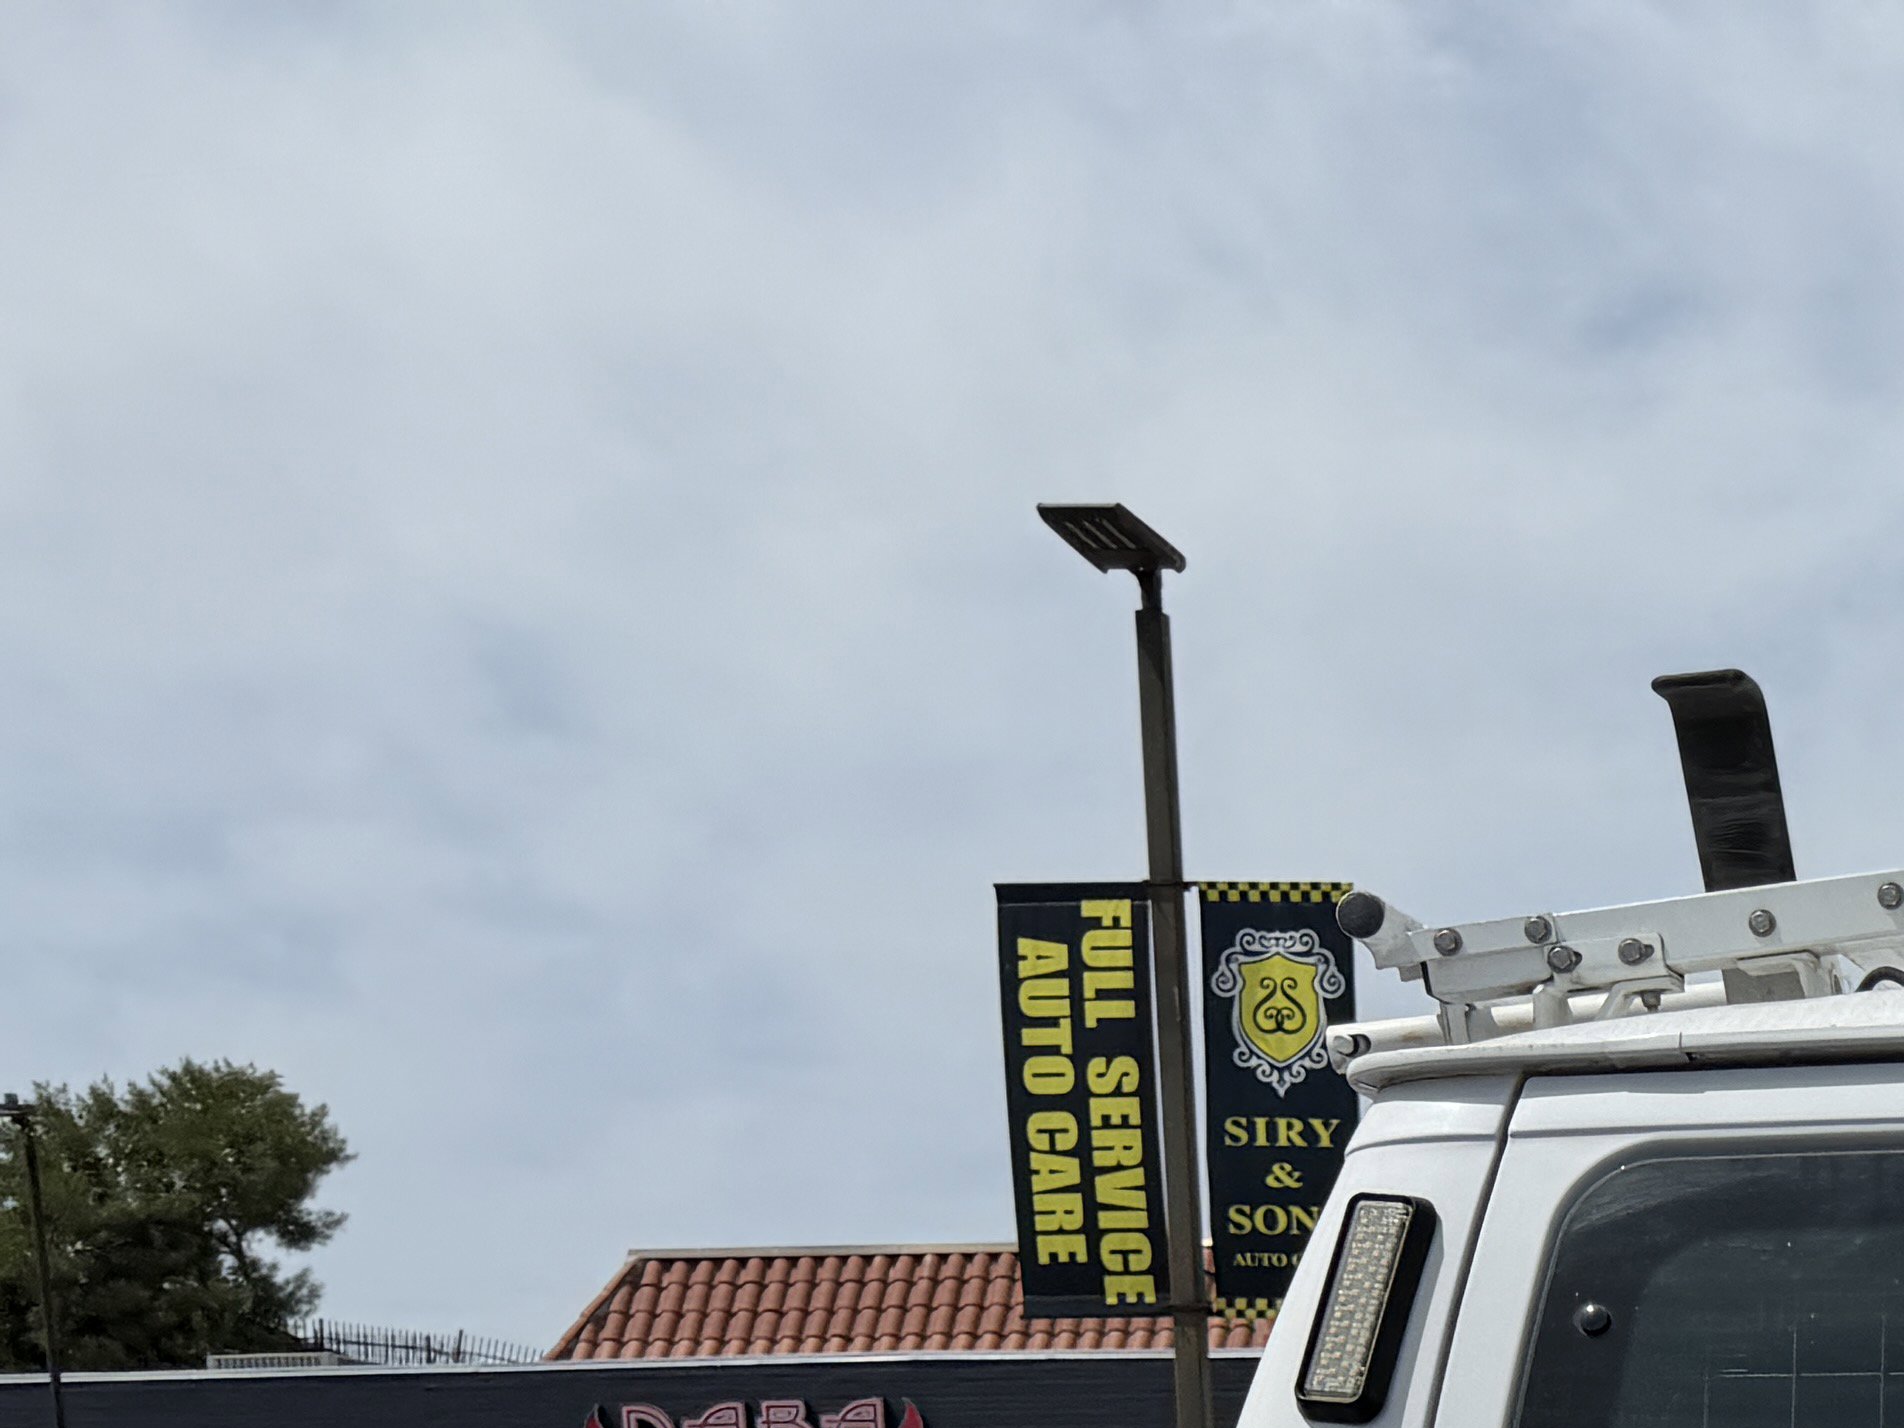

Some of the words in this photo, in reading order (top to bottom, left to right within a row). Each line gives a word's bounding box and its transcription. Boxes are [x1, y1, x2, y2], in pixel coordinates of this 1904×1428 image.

[1080, 899, 1136, 1029] FULL
[1016, 937, 1076, 1095] AUTO
[1224, 1116, 1341, 1148] SIRY
[1025, 1109, 1088, 1265] CARE
[1086, 1055, 1157, 1306] SERVICE
[1265, 1163, 1303, 1189] &
[1227, 1205, 1320, 1236] SON
[1232, 1251, 1289, 1268] AUTO
